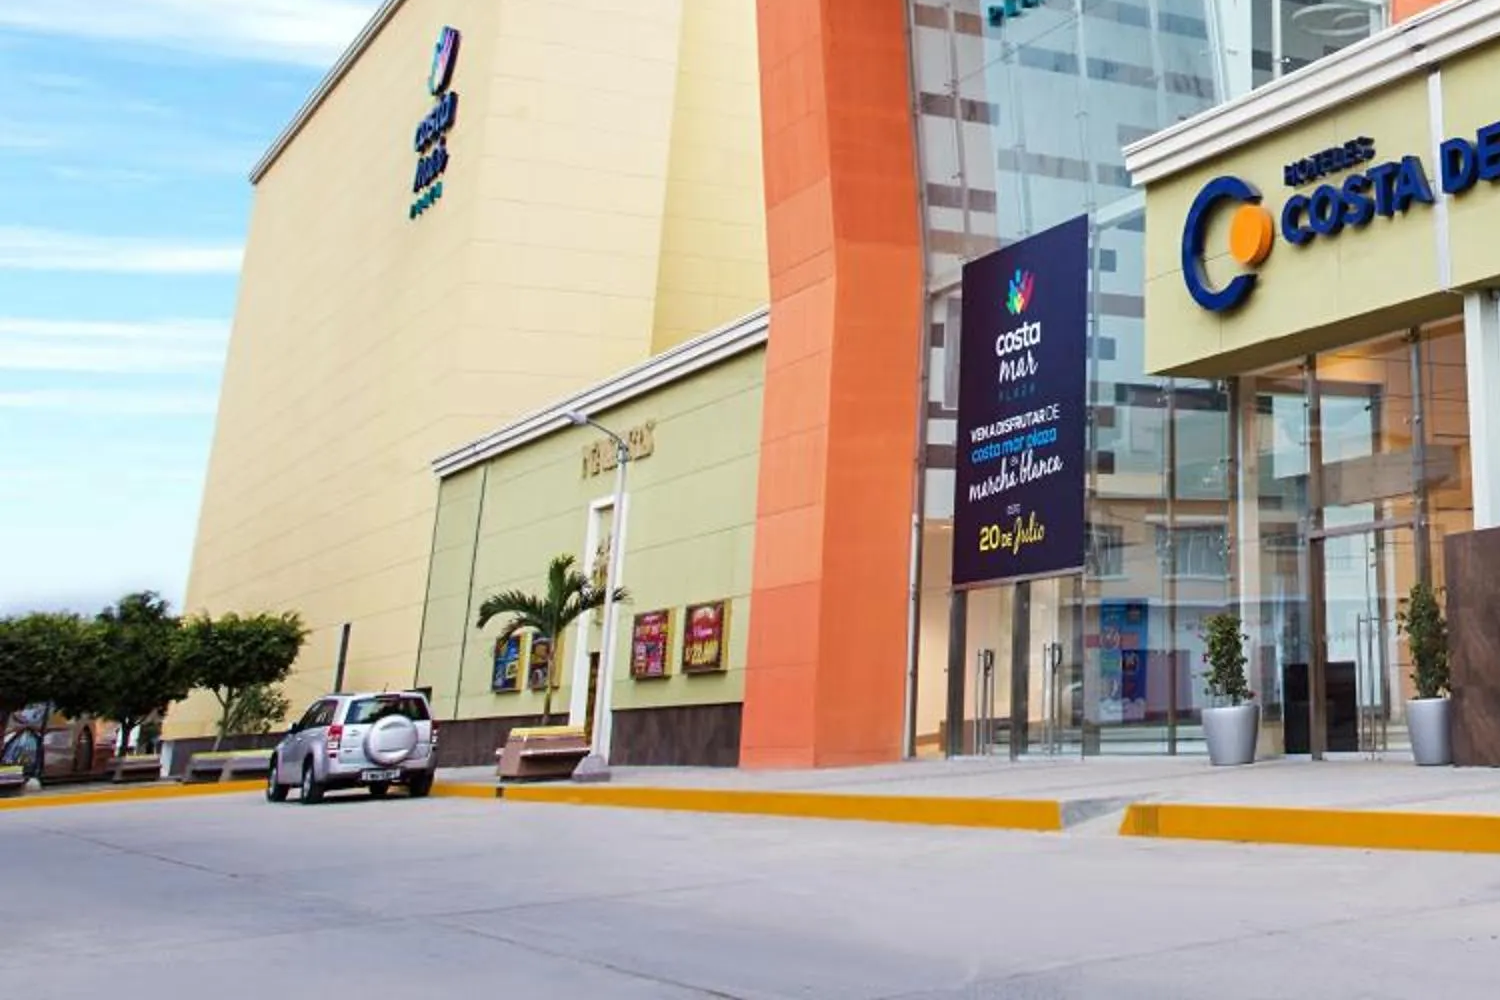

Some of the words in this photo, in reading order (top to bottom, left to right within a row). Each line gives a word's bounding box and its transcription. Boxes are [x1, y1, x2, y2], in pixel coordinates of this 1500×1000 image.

[1281, 155, 1434, 247] COSTA
[996, 321, 1041, 357] costa
[999, 350, 1039, 384] mar
[1045, 403, 1060, 421] DE
[971, 442, 1001, 464] costa
[969, 456, 1019, 502] marcha
[1020, 448, 1064, 484] blanca
[980, 524, 1000, 552] 20
[1001, 532, 1012, 548] DE
[1013, 510, 1045, 555] Julio
